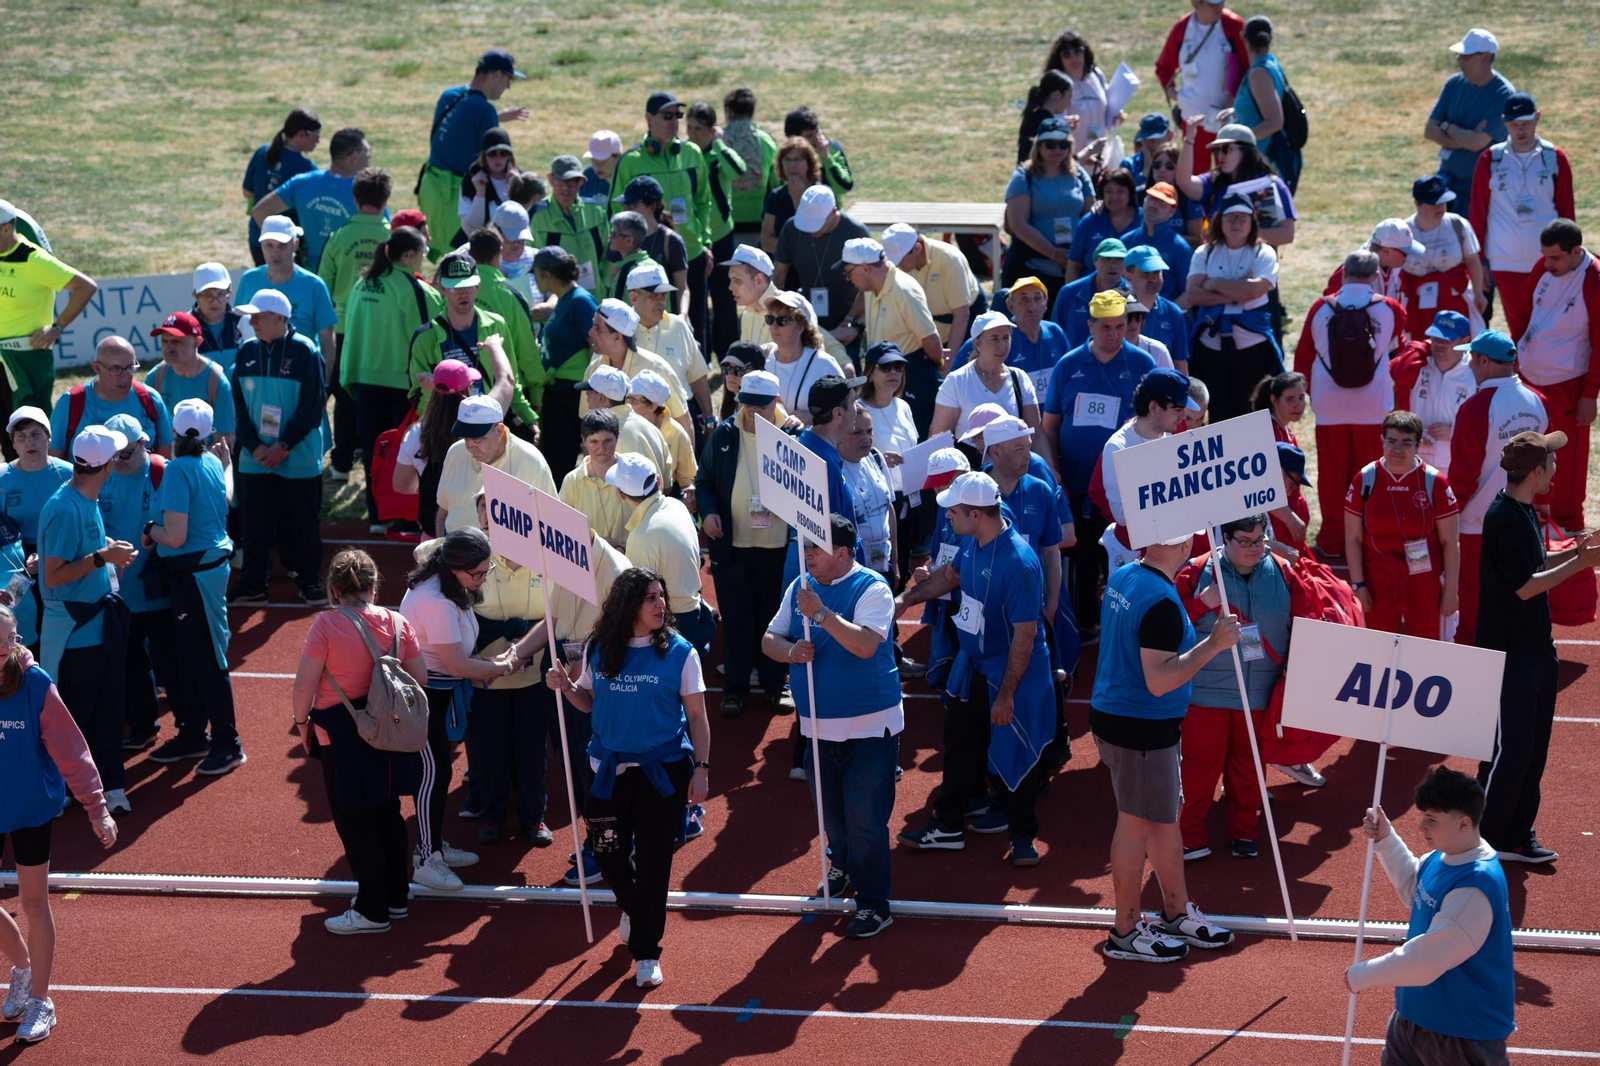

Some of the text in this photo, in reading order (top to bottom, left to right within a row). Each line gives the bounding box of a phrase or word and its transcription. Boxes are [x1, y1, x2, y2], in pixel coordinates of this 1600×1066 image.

[1088, 401, 1106, 415] 88
[776, 440, 806, 476] CAMP
[1177, 434, 1224, 469] SAN
[763, 453, 824, 516] REDONDELA
[1138, 452, 1267, 510] FRANCISCO
[1243, 487, 1276, 509] VIGO
[490, 498, 590, 572] CAMP SARRIA
[796, 510, 826, 542] REDONDELA
[609, 682, 638, 693] GALICIA
[624, 674, 659, 684] OLYMPICS
[1334, 662, 1453, 718] ADO
